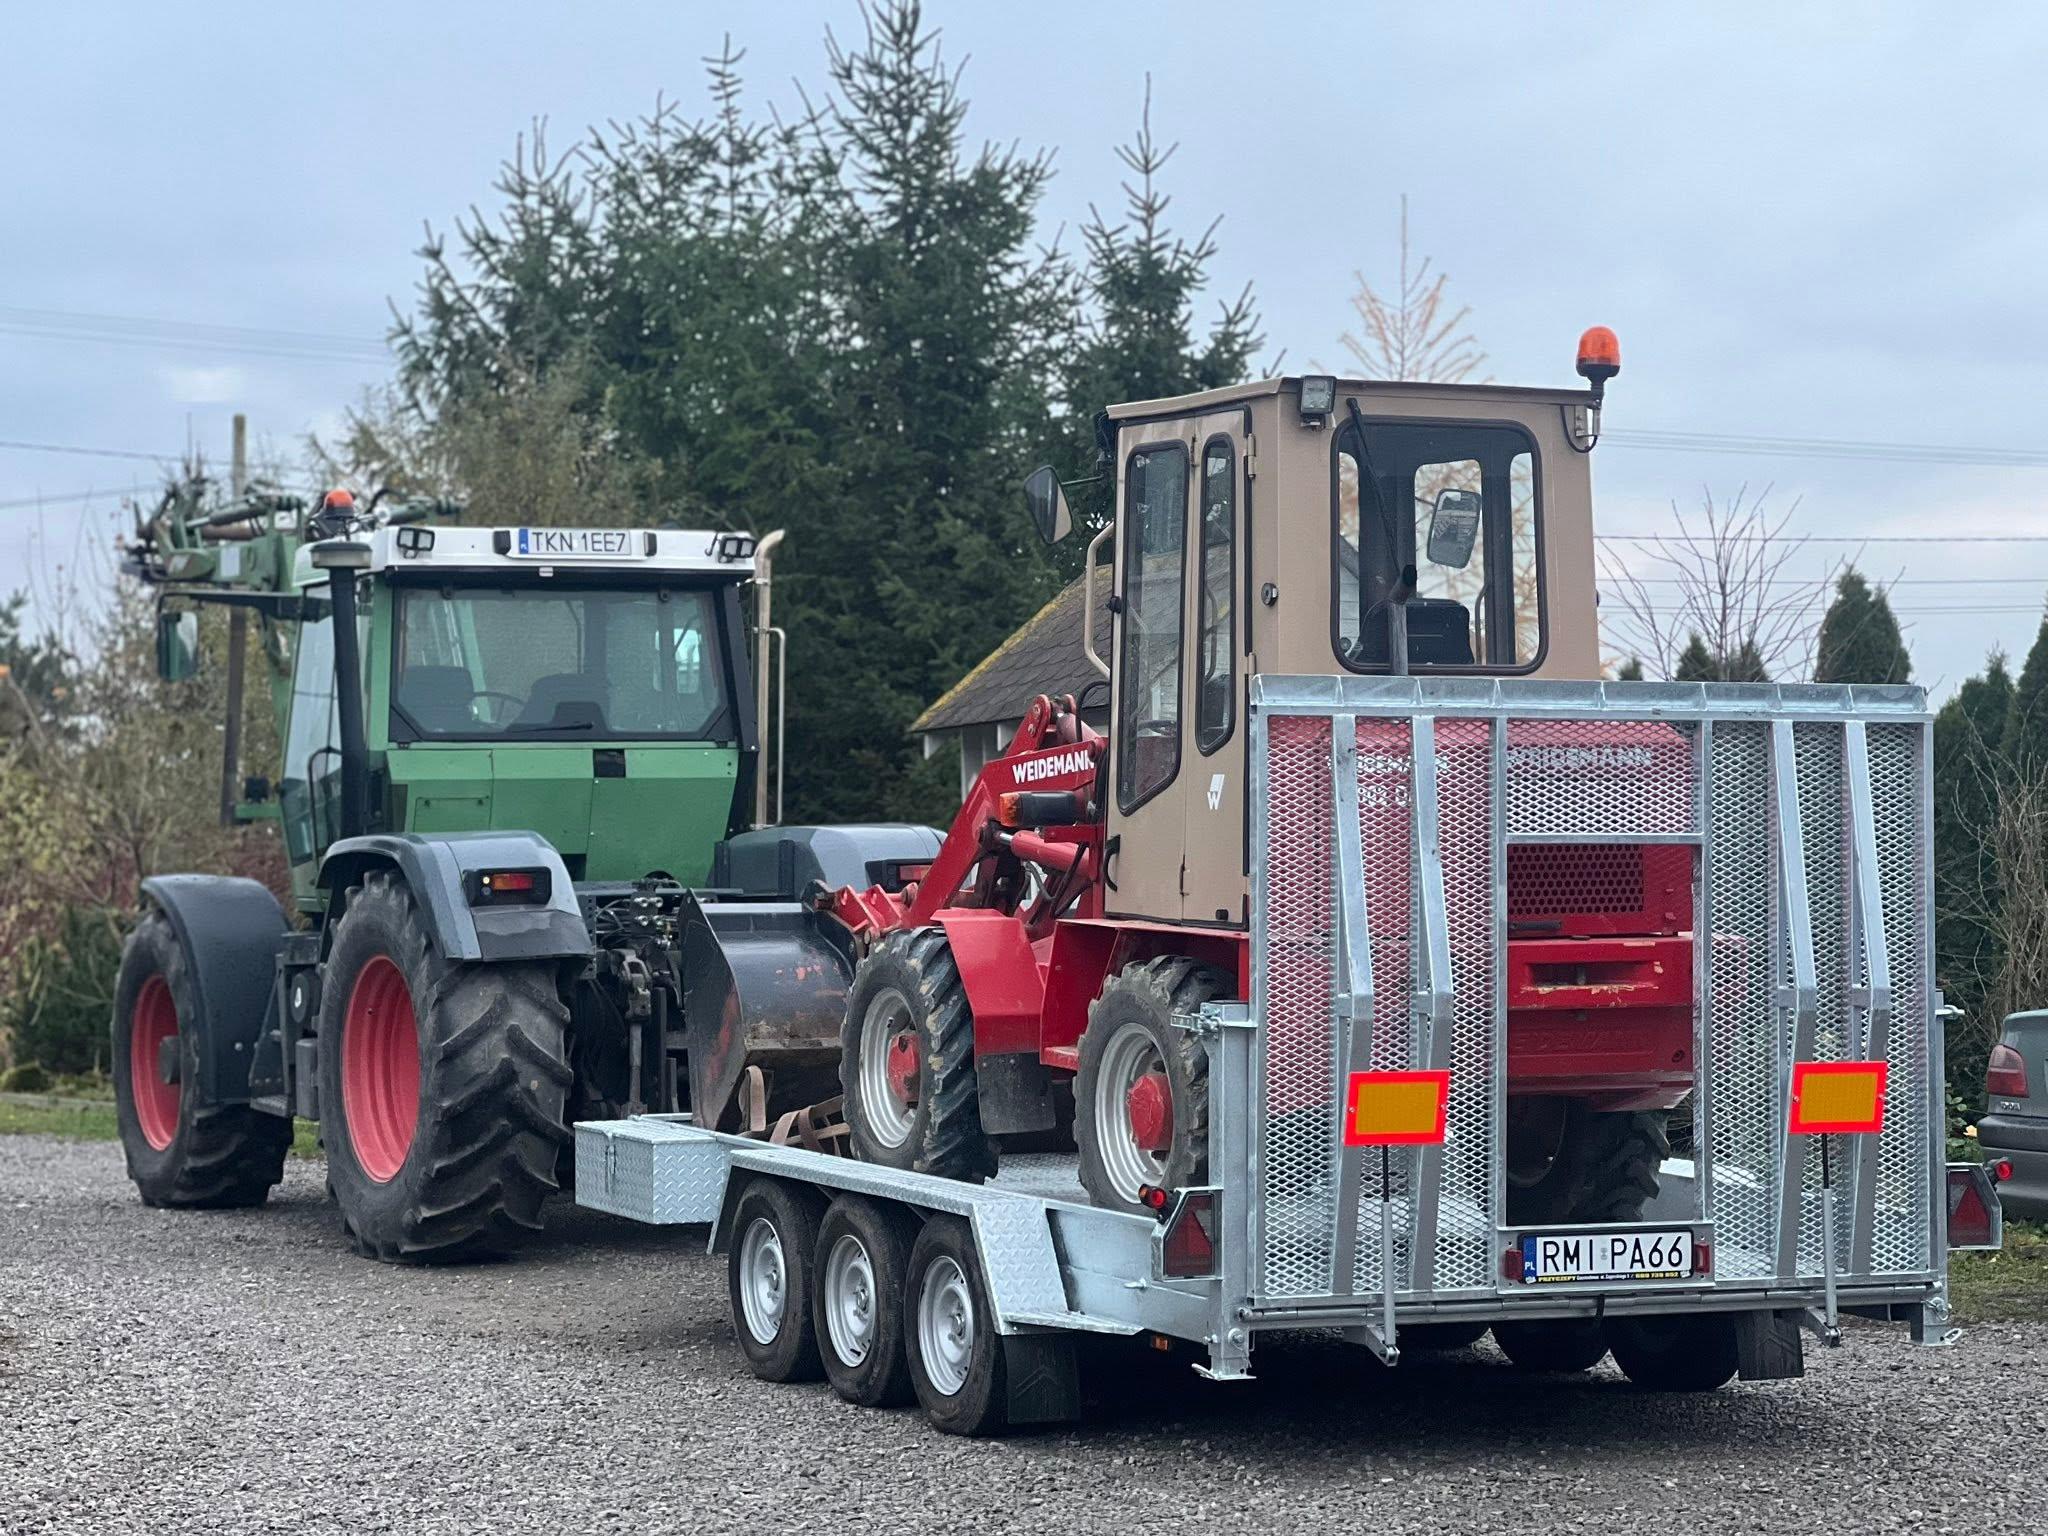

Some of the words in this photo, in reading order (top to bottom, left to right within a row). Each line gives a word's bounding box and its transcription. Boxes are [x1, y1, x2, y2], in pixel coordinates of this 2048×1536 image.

[532, 531, 574, 552] TKN
[581, 532, 626, 553] 1EE7
[1543, 1239, 1594, 1273] RMI
[1610, 1236, 1683, 1270] PA66
[1525, 1261, 1535, 1271] PL
